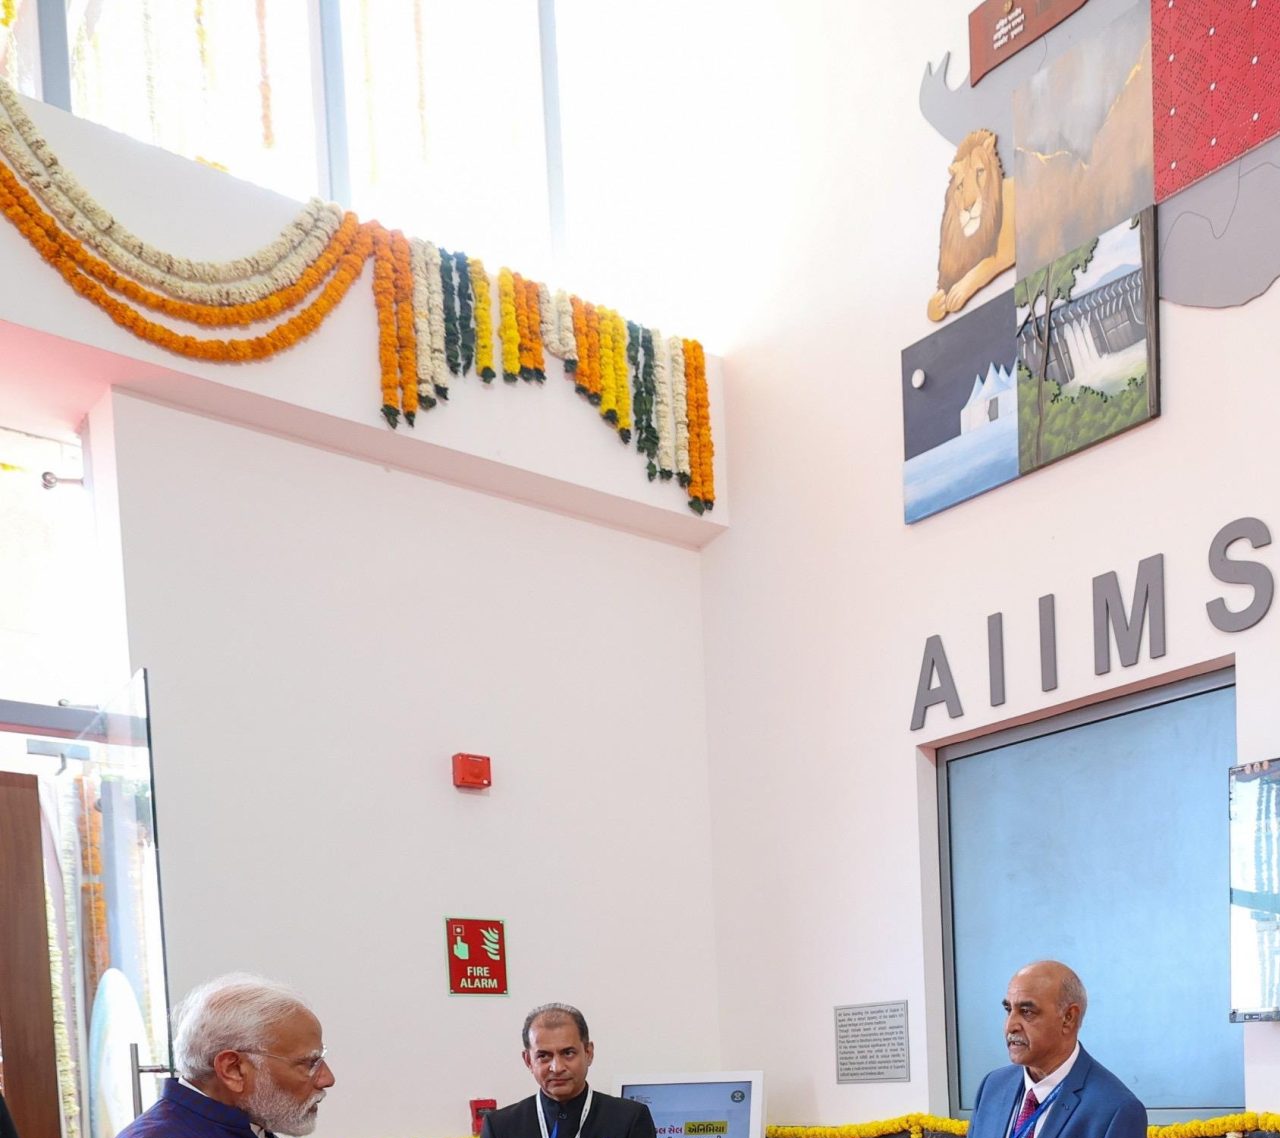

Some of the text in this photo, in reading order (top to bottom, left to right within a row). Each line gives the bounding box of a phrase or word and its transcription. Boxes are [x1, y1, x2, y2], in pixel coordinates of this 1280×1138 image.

[910, 517, 1275, 731] AIIMS
[466, 966, 491, 977] FIRE
[460, 977, 498, 989] ALARM
